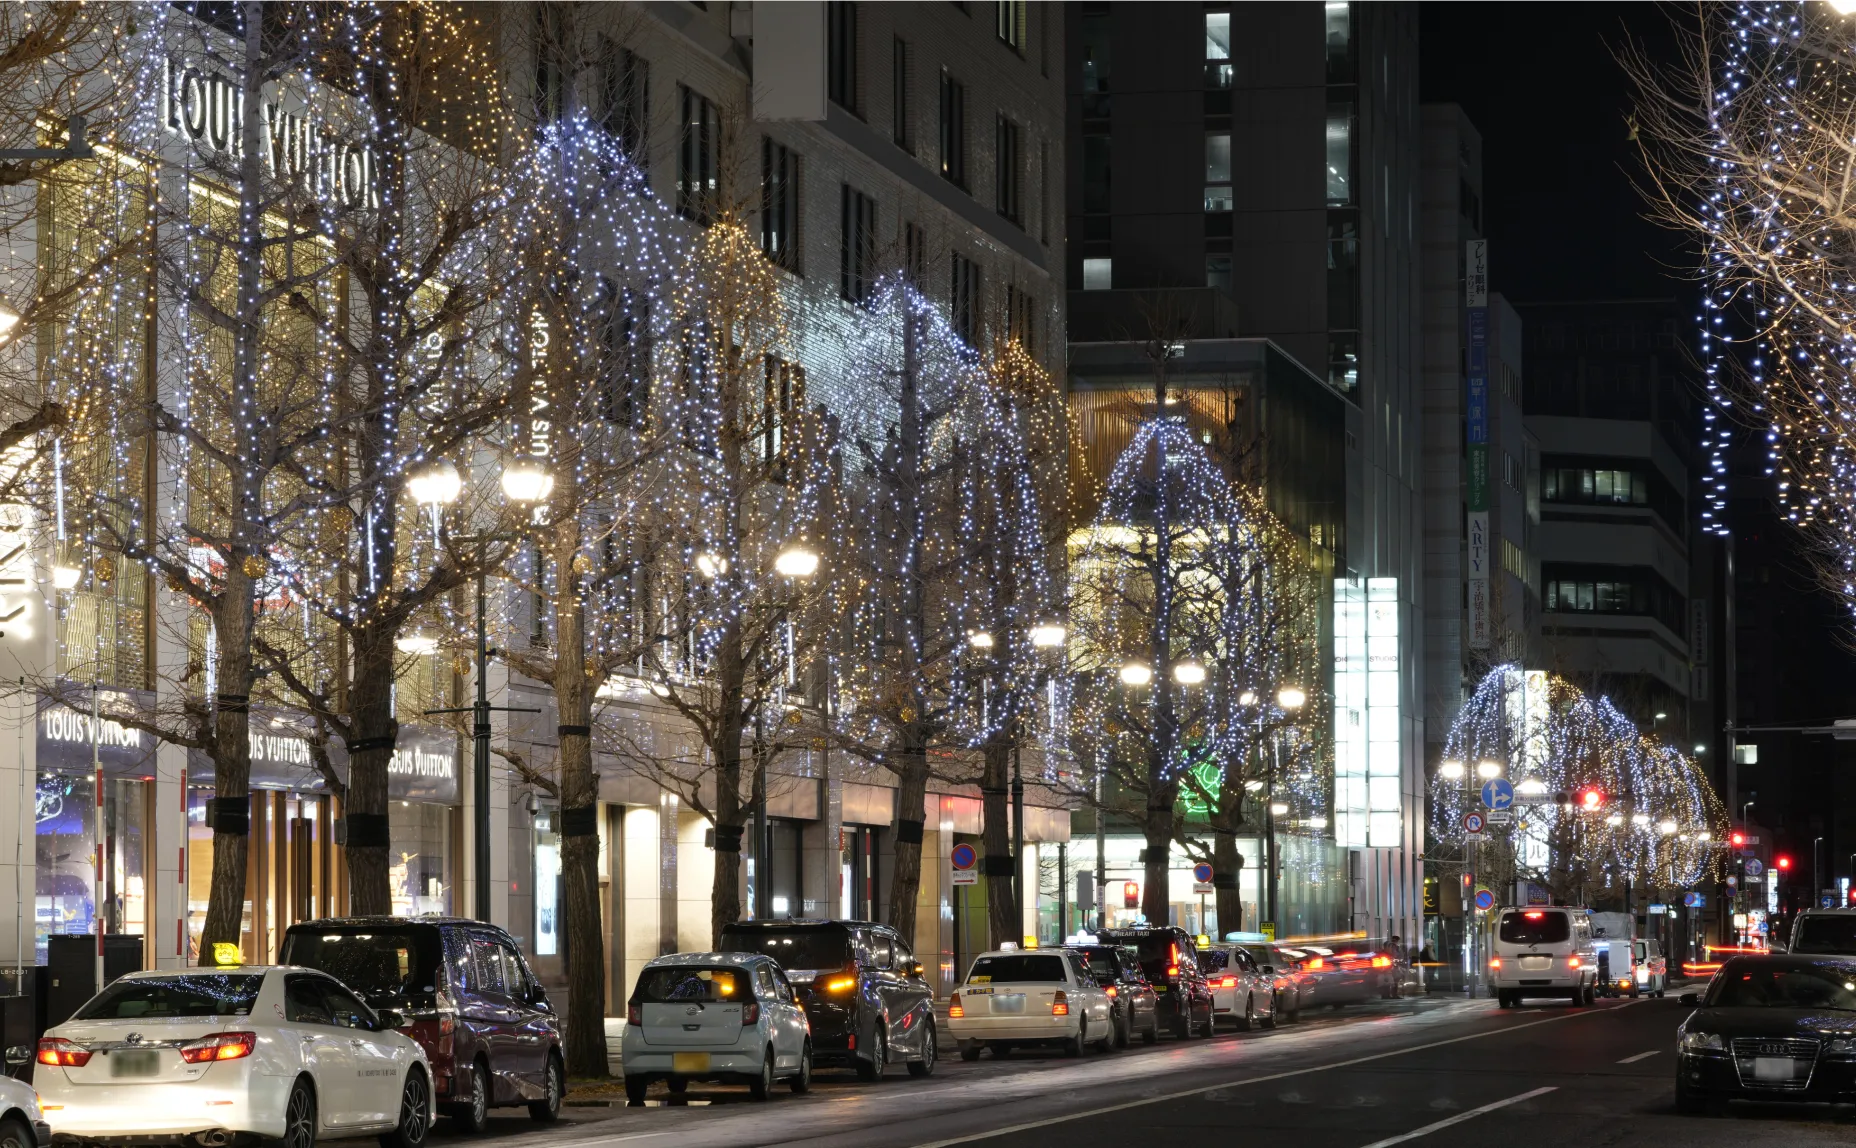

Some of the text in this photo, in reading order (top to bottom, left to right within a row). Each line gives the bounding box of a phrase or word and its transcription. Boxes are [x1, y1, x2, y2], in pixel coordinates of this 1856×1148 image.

[164, 56, 244, 160] LOUI
[1474, 242, 1485, 294] アレーゼ眼科
[1472, 519, 1483, 572] ARTY
[46, 711, 84, 742] LOUIS
[266, 736, 310, 766] VUITTON
[414, 752, 452, 779] VUITTON
